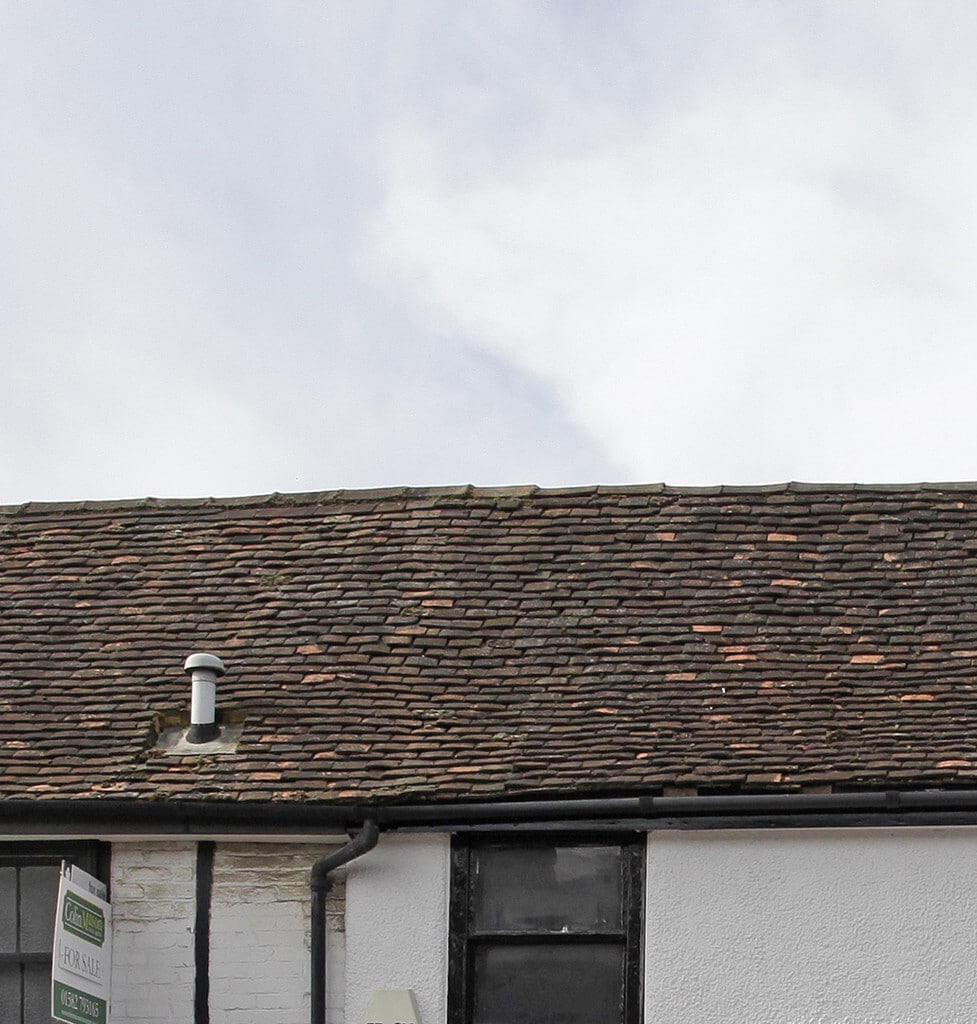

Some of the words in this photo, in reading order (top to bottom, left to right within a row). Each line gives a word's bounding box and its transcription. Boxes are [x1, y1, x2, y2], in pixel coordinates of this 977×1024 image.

[63, 946, 80, 970] FOR
[82, 953, 102, 979] SALE
[60, 989, 78, 1010] 01582
